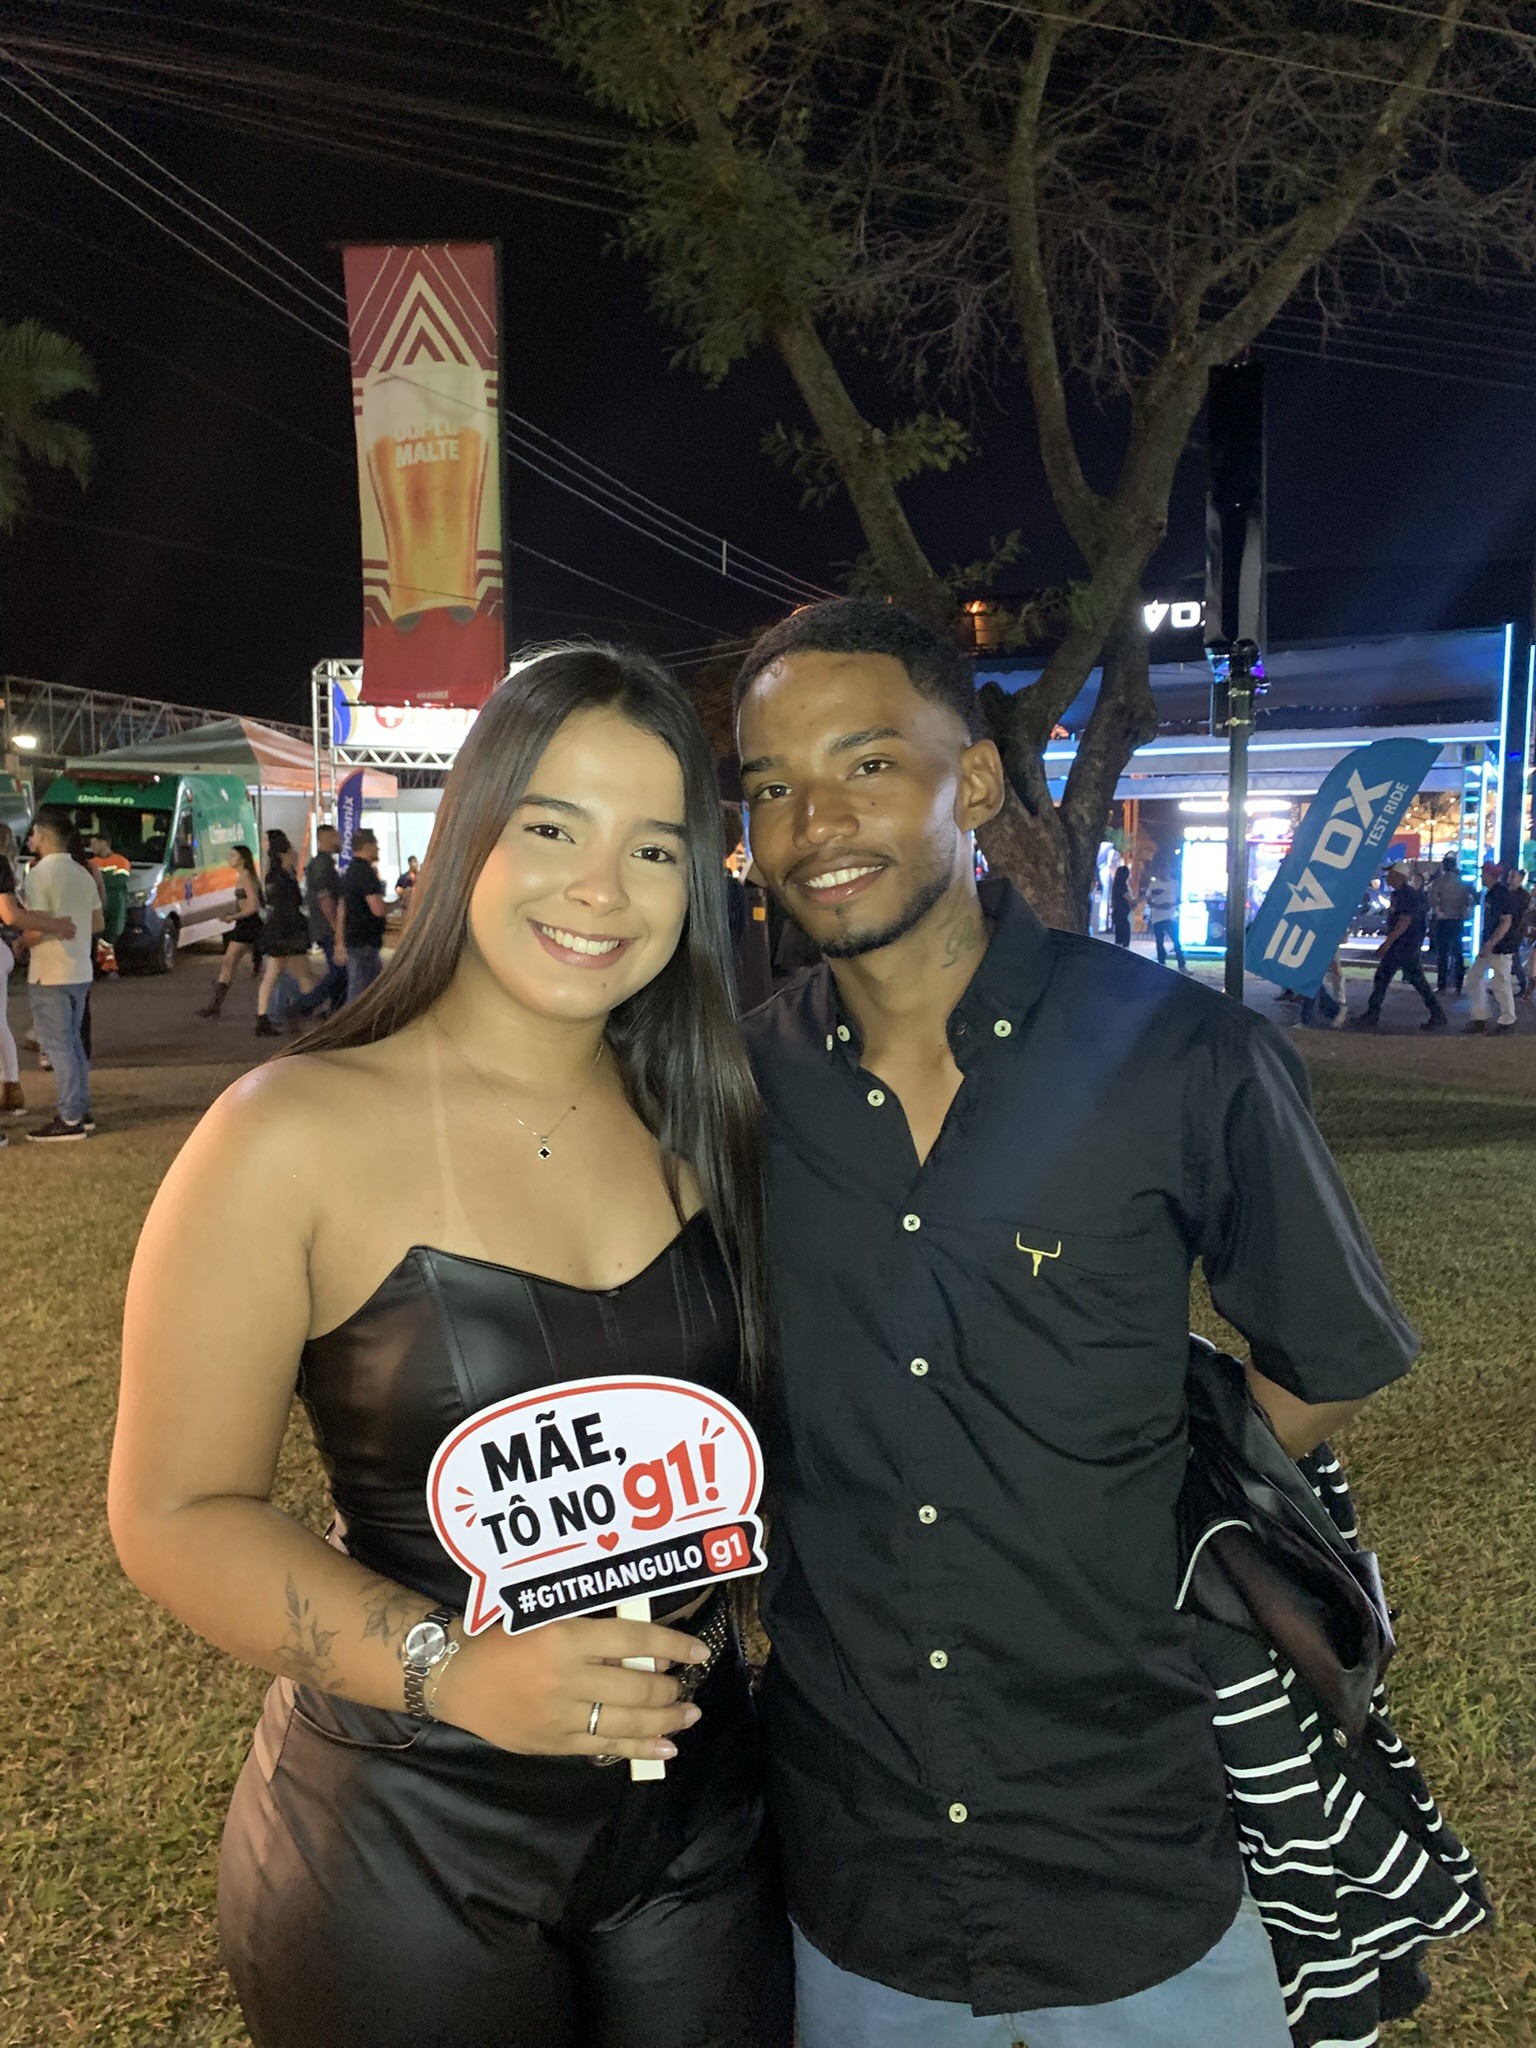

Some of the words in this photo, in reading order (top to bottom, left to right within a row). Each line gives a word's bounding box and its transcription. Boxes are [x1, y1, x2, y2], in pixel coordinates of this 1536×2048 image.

[395, 439, 460, 469] MALTE
[77, 794, 121, 804] Unimed
[341, 795, 354, 861] Phoenix
[1365, 814, 1390, 848] TEST
[1385, 781, 1410, 816] RIDE
[1263, 768, 1394, 968] EVOX
[480, 1410, 627, 1493] MÃE,
[481, 1494, 541, 1555] TÔ
[549, 1483, 616, 1537] NO
[622, 1440, 719, 1531] g1!
[517, 1545, 703, 1614] #G1TRIANGULO
[710, 1532, 743, 1568] g1
